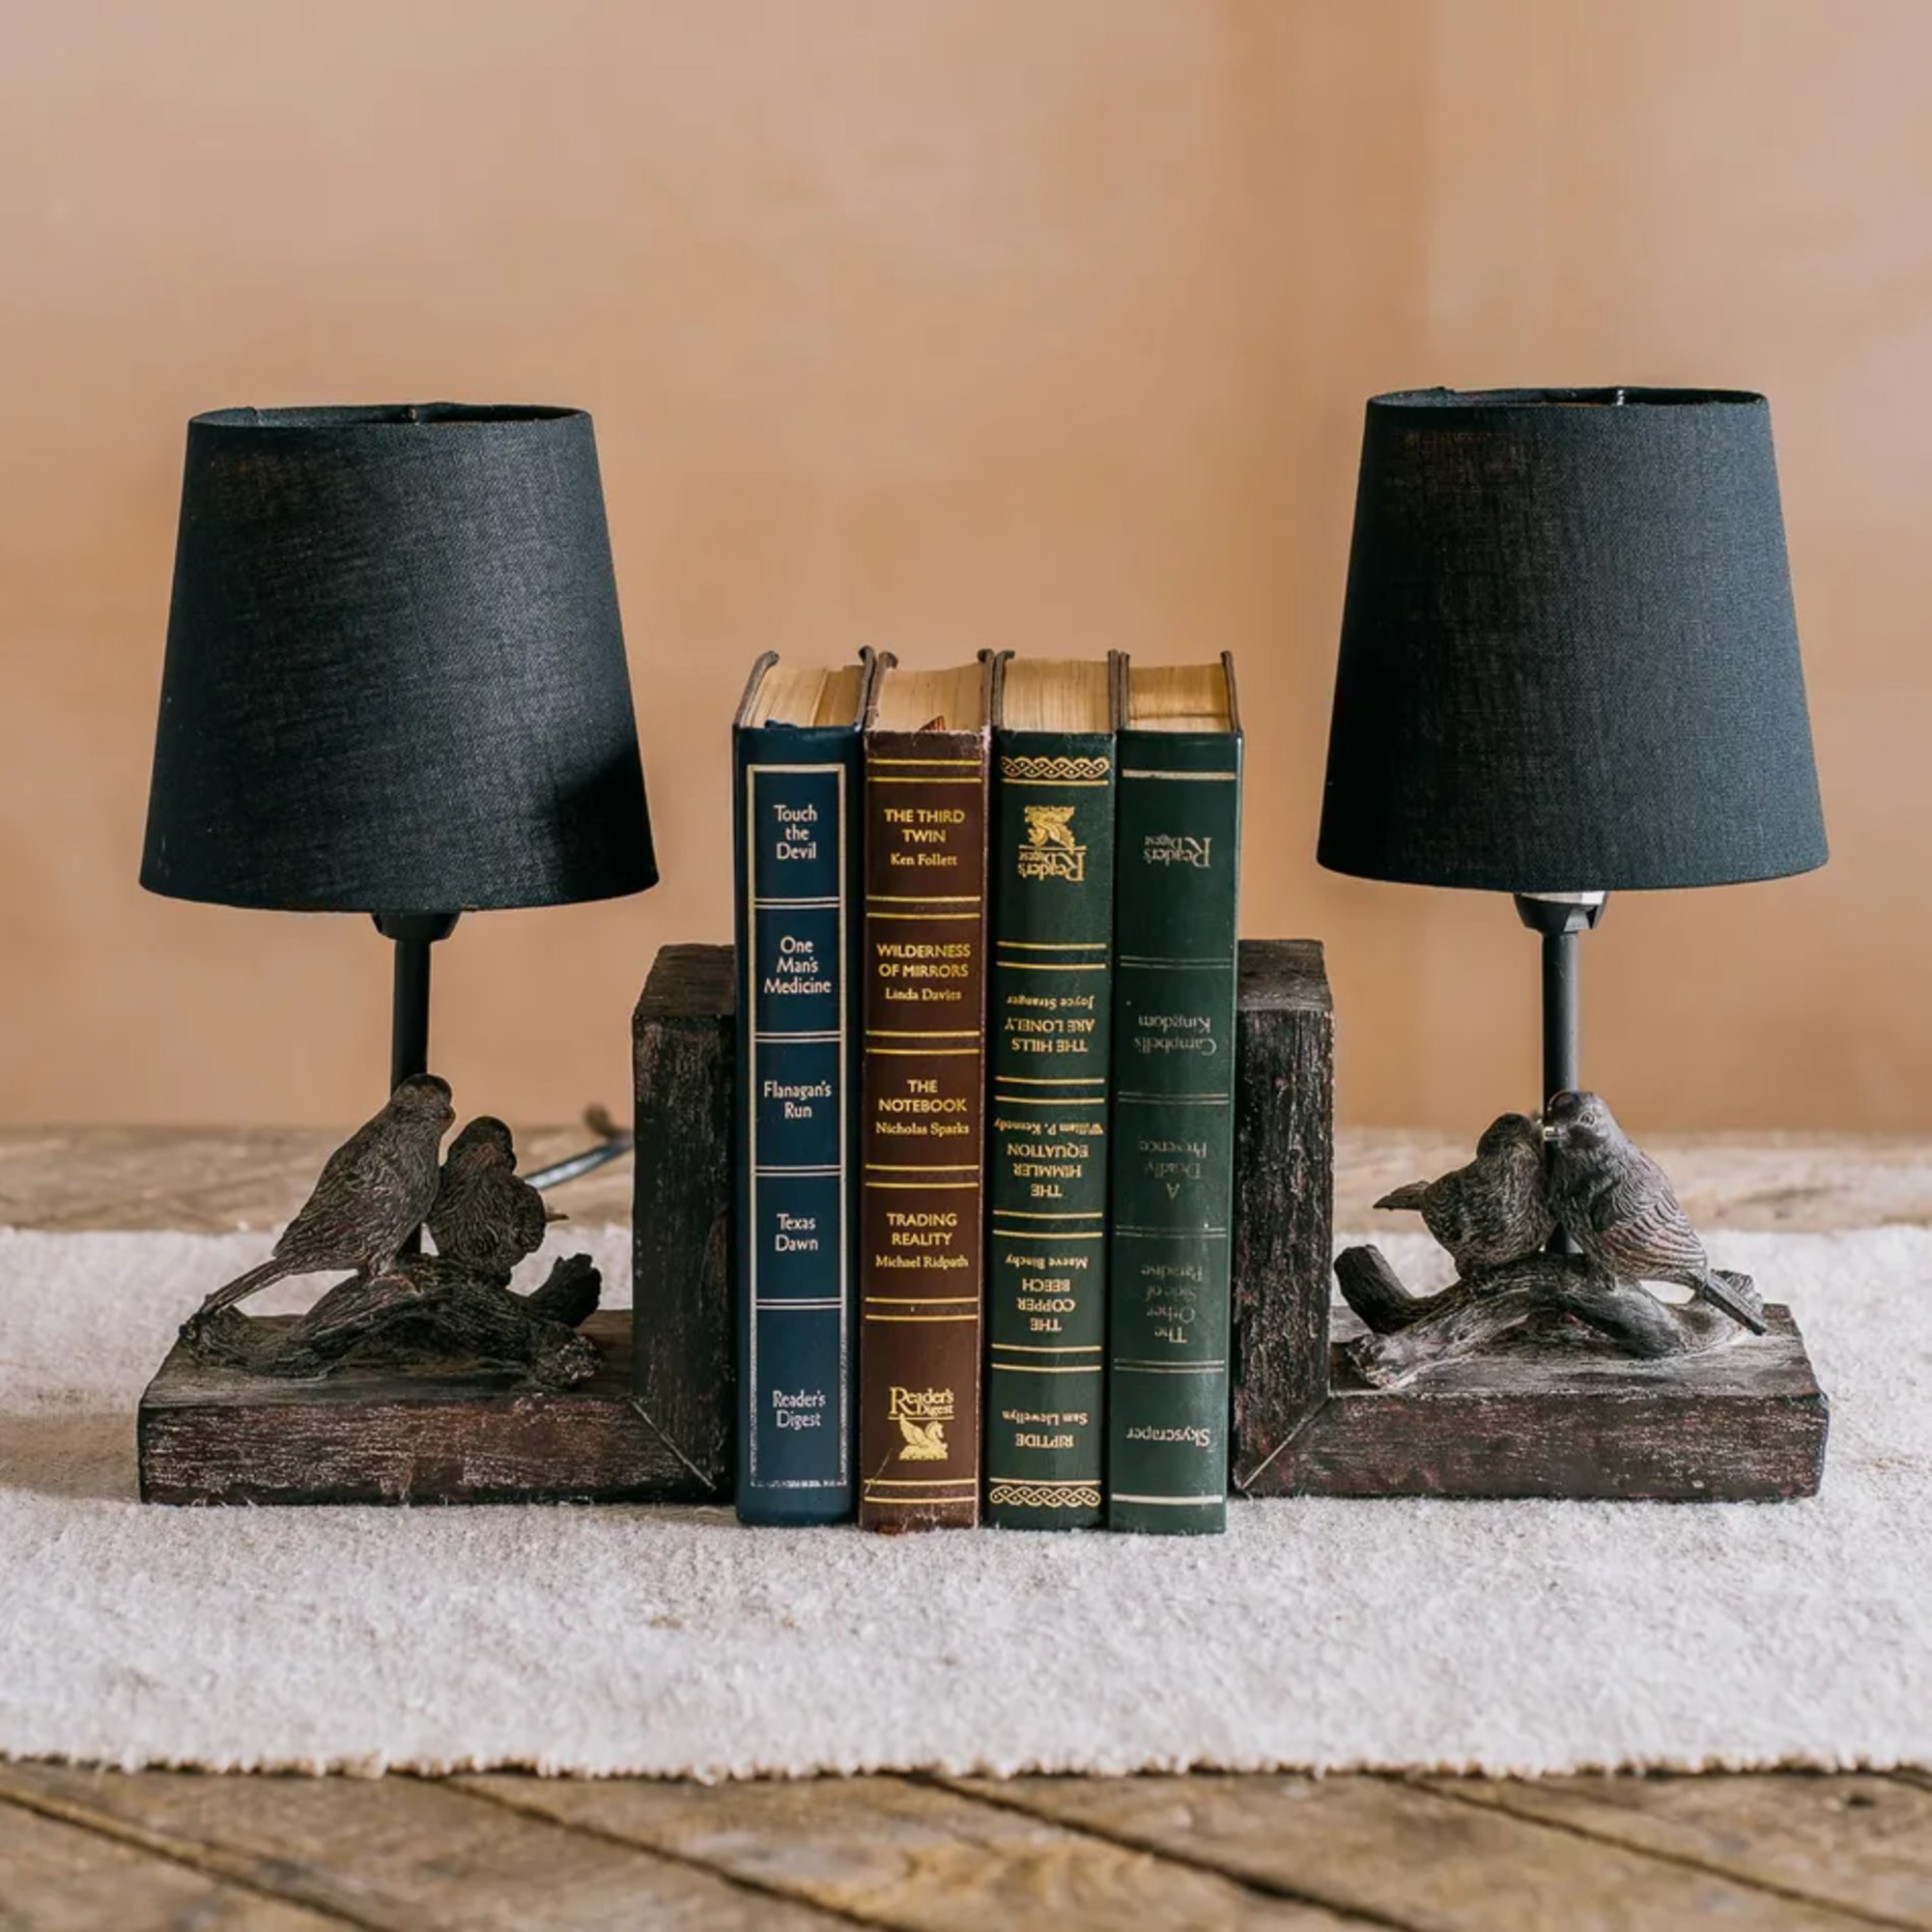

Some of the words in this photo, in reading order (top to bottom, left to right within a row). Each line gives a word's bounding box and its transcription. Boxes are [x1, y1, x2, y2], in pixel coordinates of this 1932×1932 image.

[774, 804, 818, 821] Touch
[884, 810, 914, 822] THE
[917, 810, 965, 823] THIRD
[784, 824, 810, 840] the
[902, 830, 946, 842] TWIN
[1145, 834, 1182, 848] Digest
[776, 842, 816, 860] Devil
[1018, 851, 1056, 863] Digest
[1145, 837, 1212, 867] Reader's
[891, 853, 915, 866] Ken
[918, 853, 957, 866] Follett
[1018, 852, 1087, 881] Reader's
[781, 936, 813, 953] One
[876, 944, 971, 958] WILDERNESS
[776, 957, 818, 974] Man's
[878, 965, 899, 977] OF
[902, 964, 969, 978] MIRRORS
[764, 978, 832, 994] Medicine
[885, 988, 918, 1000] Linda
[922, 988, 961, 1001] Davies
[1007, 996, 1057, 1010] Stranger
[1061, 995, 1094, 1009] Joyce
[1005, 1018, 1065, 1032] LONELY
[1067, 1019, 1095, 1032] ARE
[1138, 1015, 1210, 1033] Kingdom
[1012, 1038, 1053, 1052] HILLS
[1057, 1039, 1088, 1052] THE
[1134, 1037, 1217, 1056] Campbell's
[764, 1080, 832, 1100] Flanagan's
[907, 1080, 938, 1094] THE
[784, 1102, 812, 1119] Run
[878, 1099, 967, 1112] NOTEBOOK
[875, 1122, 927, 1135] Nicholas
[930, 1122, 969, 1137] Sparks
[994, 1119, 1041, 1134] Kennedy
[1045, 1122, 1056, 1134] P.
[1059, 1123, 1103, 1135] William
[1007, 1143, 1089, 1157] EQUATION
[1140, 1139, 1207, 1156] Presence
[1013, 1164, 1082, 1178] HIMMLER
[1031, 1184, 1063, 1197] THE
[1166, 1183, 1180, 1199] A
[777, 1213, 816, 1231] Texas
[887, 1213, 957, 1227] TRADING
[775, 1235, 818, 1251] Dawn
[892, 1233, 952, 1245] REALITY
[875, 1256, 920, 1267] Michael
[923, 1255, 968, 1269] Ridpath
[1005, 1254, 1045, 1268] Binchy
[1049, 1257, 1089, 1269] Maeve
[1141, 1264, 1203, 1281] Paradise
[1022, 1279, 1070, 1292] BEECH
[1147, 1286, 1162, 1300] of
[1016, 1298, 1075, 1312] COPPER
[1147, 1308, 1195, 1323] Other
[1030, 1319, 1062, 1331] THE
[1155, 1327, 1187, 1343] The
[772, 1390, 826, 1408] Reader's
[888, 1387, 954, 1415] Reader's
[917, 1405, 953, 1417] Digest
[1002, 1410, 1059, 1425] Llewellyn
[1063, 1412, 1088, 1424] Sam
[776, 1410, 821, 1430] Digest
[1015, 1433, 1074, 1448] RIPTIDE
[1126, 1426, 1210, 1446] Skyscraper
